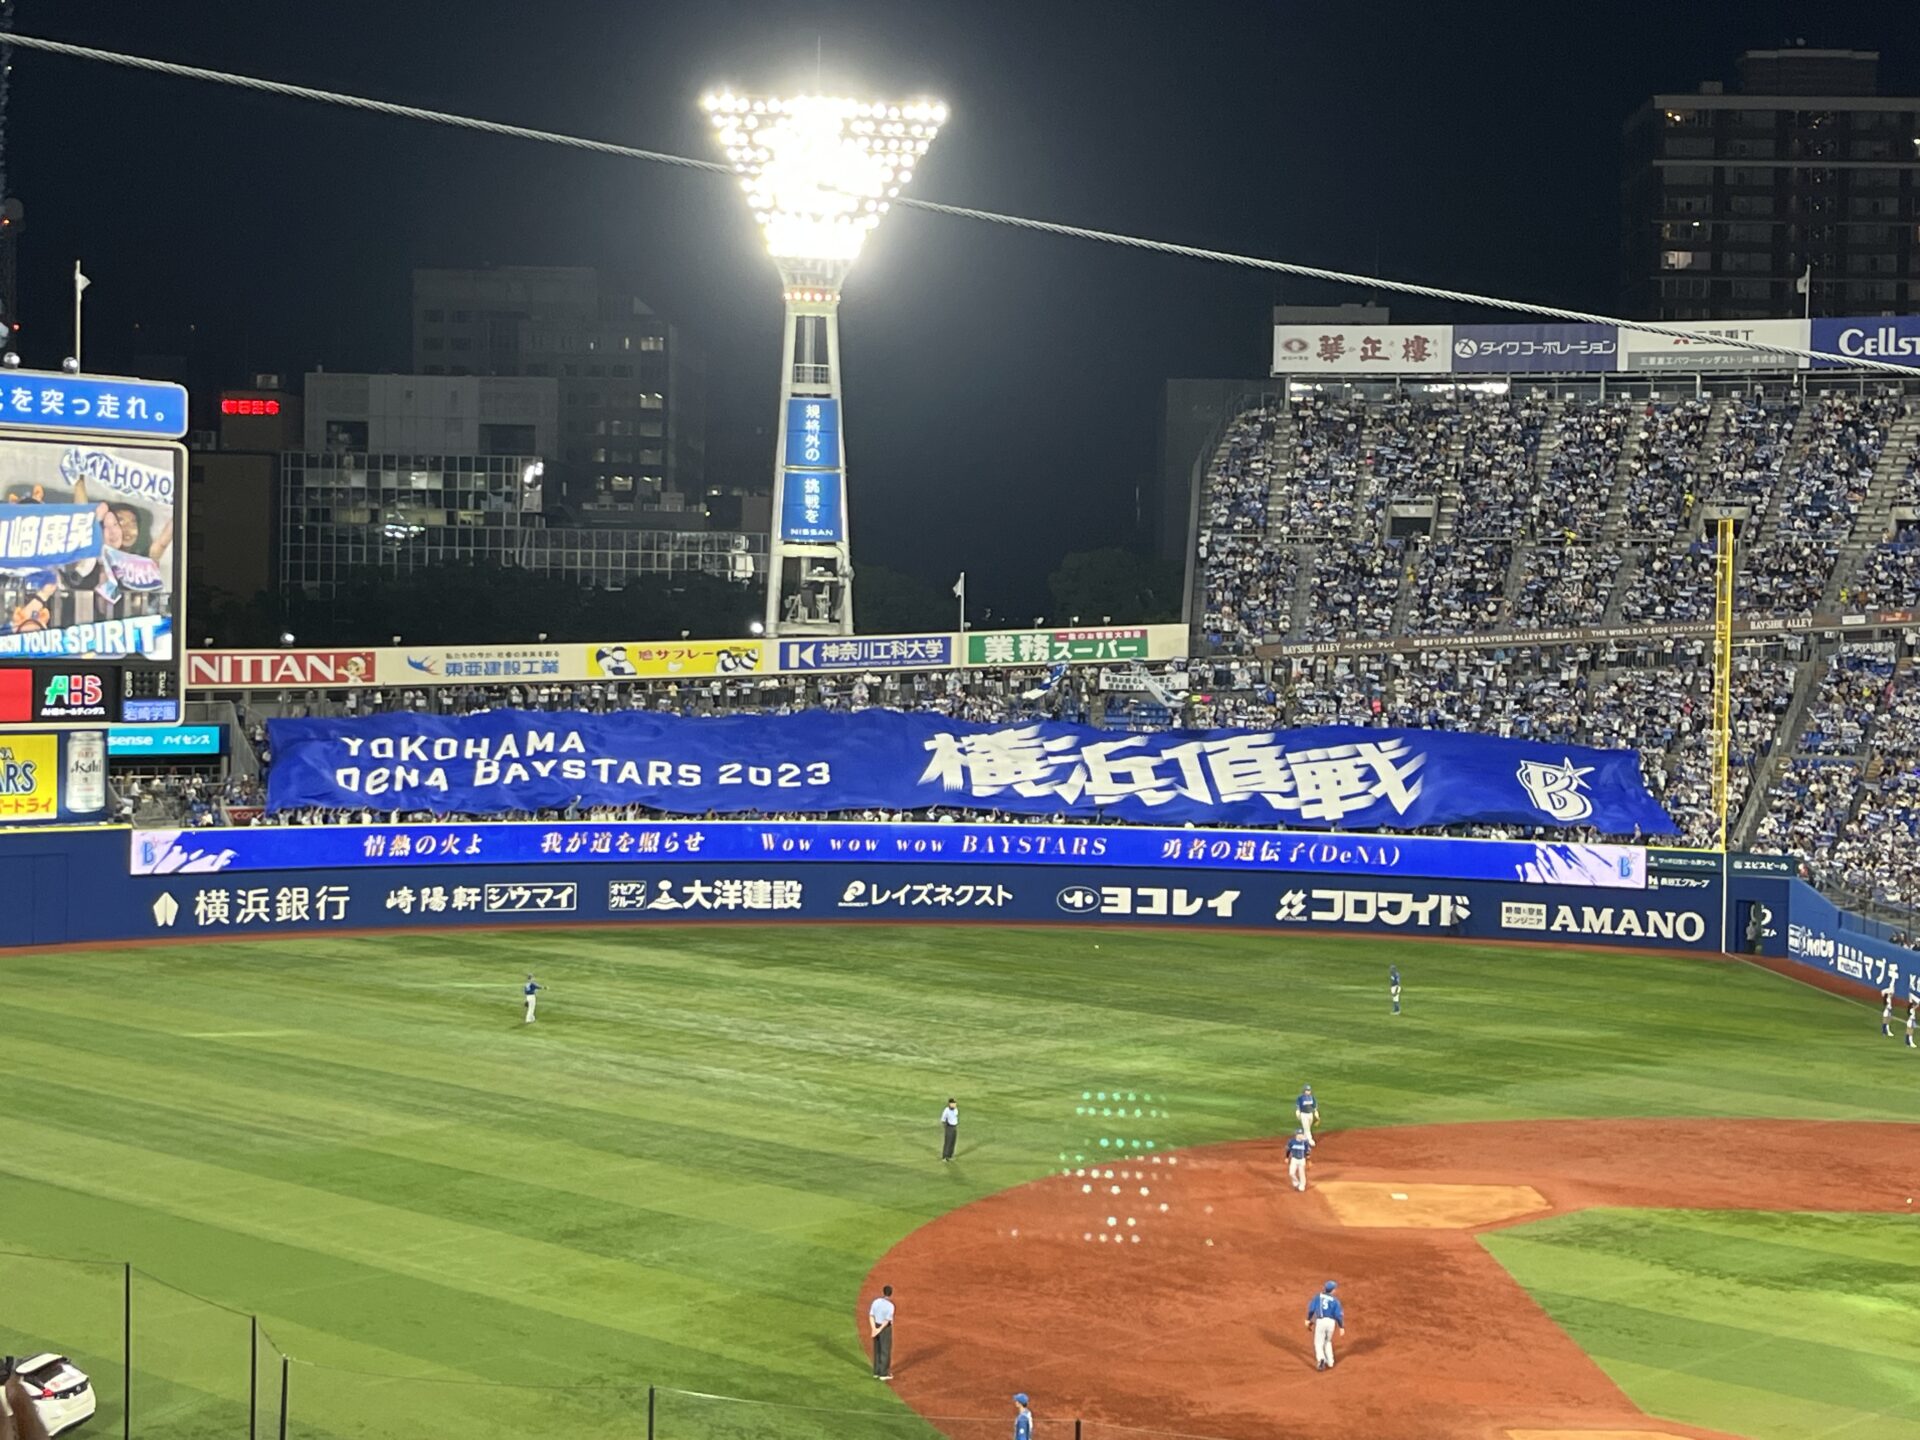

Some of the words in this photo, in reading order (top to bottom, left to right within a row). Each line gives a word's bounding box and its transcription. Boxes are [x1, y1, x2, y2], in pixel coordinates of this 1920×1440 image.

[1479, 340, 1616, 356] ダイワコーポレーション
[0, 387, 166, 421] を突っ走れ。
[790, 528, 834, 536] NISSAN
[23, 628, 64, 653] YOUR
[65, 614, 162, 655] SPIRIT
[1787, 618, 1813, 628] ALLEY
[821, 639, 944, 661] 神奈川工科大学
[984, 634, 1138, 663] 業務スーパー
[1316, 643, 1341, 653] ALLEY
[190, 654, 335, 683] NITTAN
[445, 660, 559, 676] 東亜建設工業
[162, 735, 210, 745] ハイセンス
[339, 730, 586, 762] YOKOHAMA
[473, 758, 702, 787] BAYSTARS
[718, 762, 831, 787] 2023
[917, 723, 1426, 819] 横浜頂戦
[0, 798, 52, 813] ードライ
[363, 834, 483, 857] 情熱の火よ
[540, 831, 706, 854] 我が道を照らせ
[761, 833, 813, 851] Wow
[830, 838, 880, 852] wow
[897, 838, 946, 853] wow
[962, 834, 1108, 856] BAYSTARS
[386, 886, 481, 913] 崎陽軒
[486, 886, 575, 909] シウマイ
[610, 883, 645, 895] オセアン
[682, 880, 803, 911] 大洋建設
[870, 884, 1013, 907] レイズネクスト
[195, 885, 350, 926] 横浜銀行
[610, 896, 645, 909] グループ
[1101, 886, 1241, 917] ヨコレイ
[1311, 889, 1471, 926] コロワイド
[1551, 905, 1705, 942] AMANO
